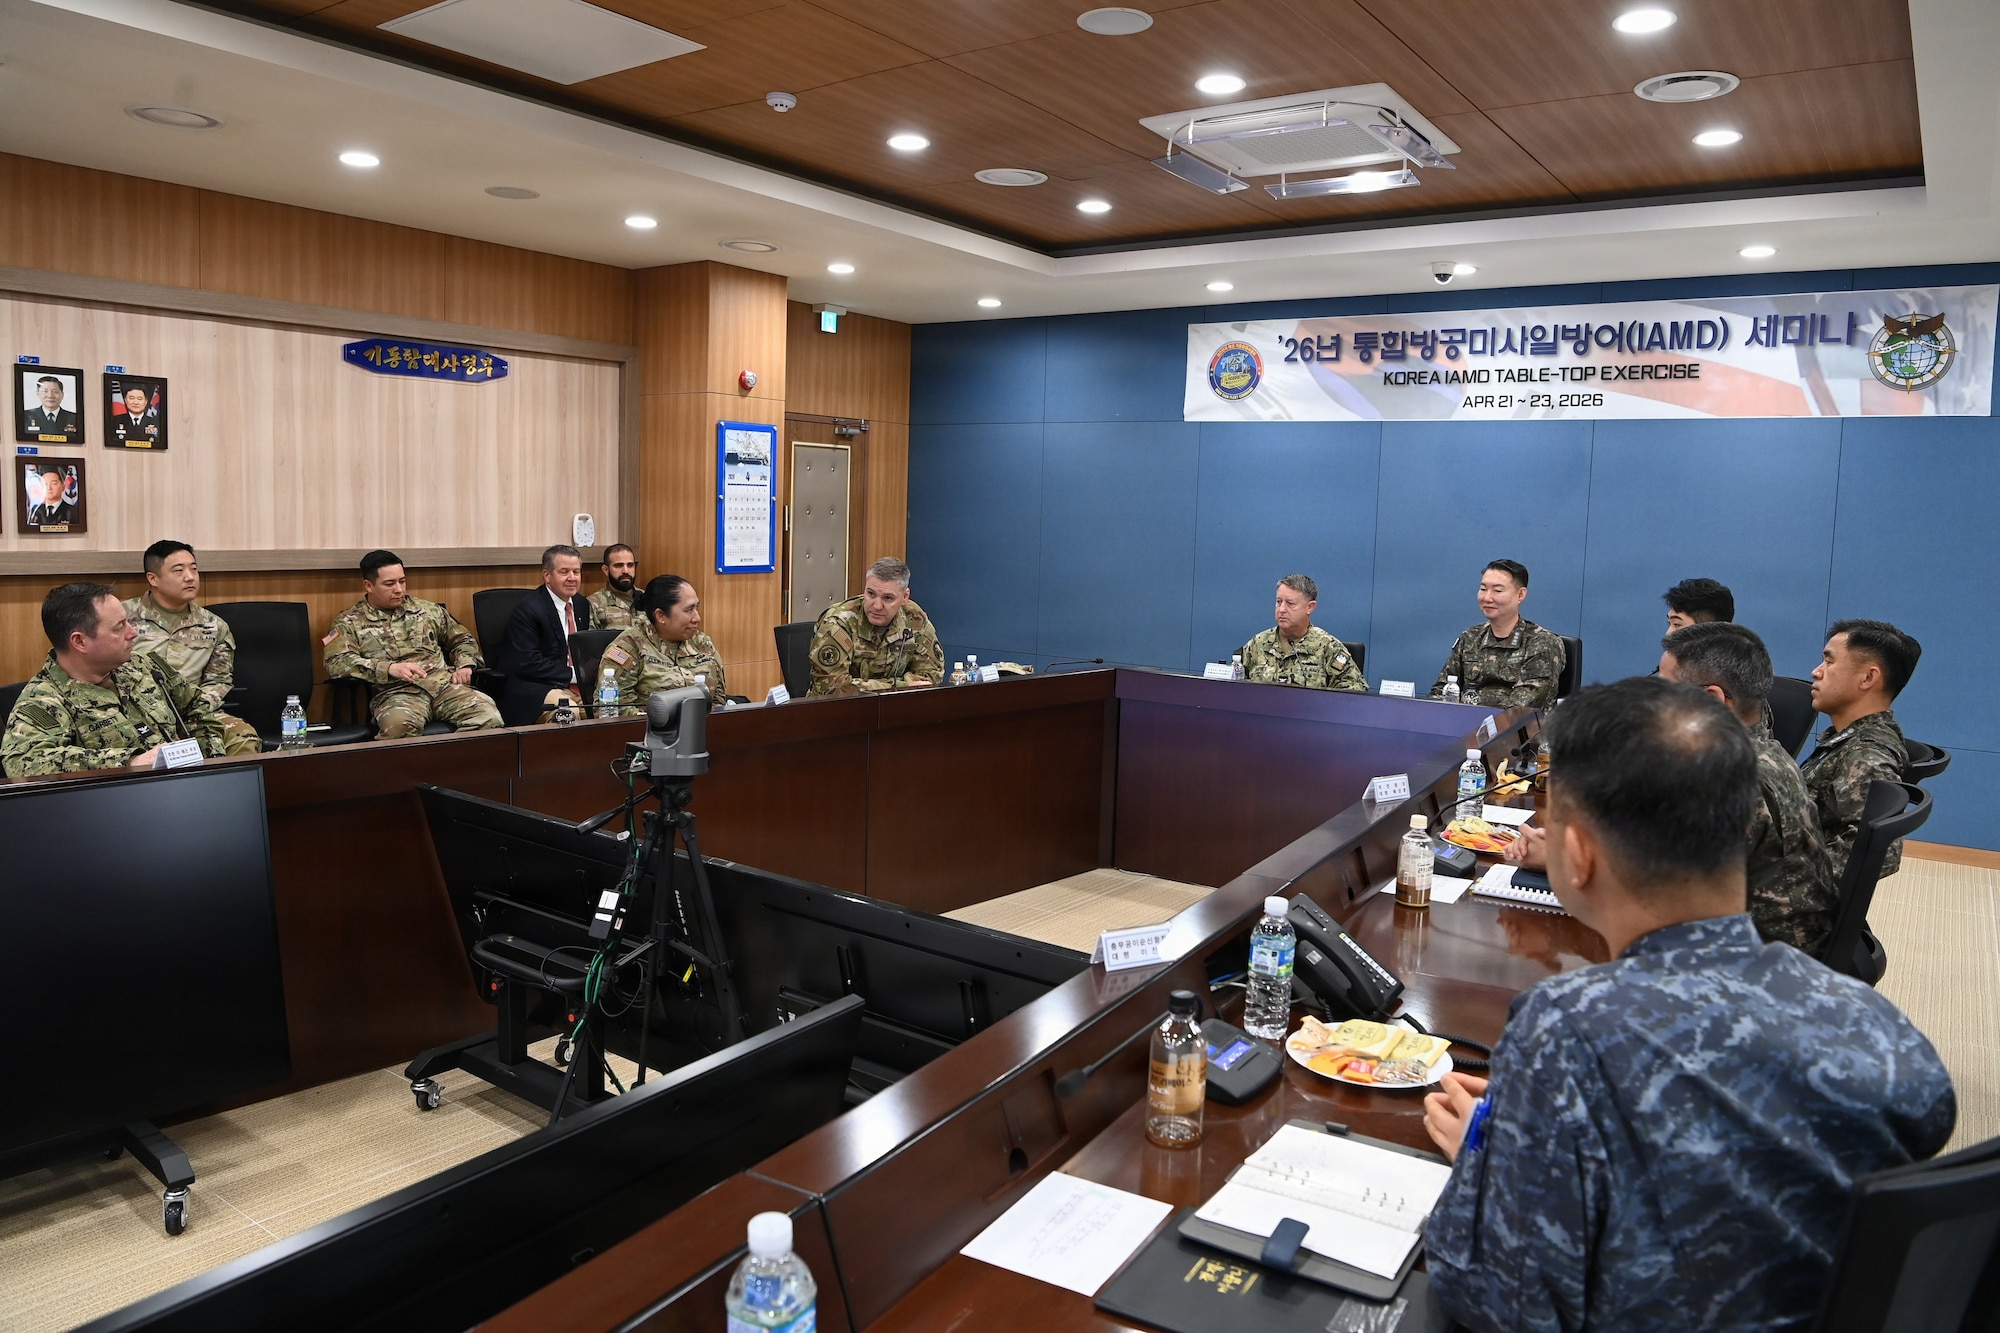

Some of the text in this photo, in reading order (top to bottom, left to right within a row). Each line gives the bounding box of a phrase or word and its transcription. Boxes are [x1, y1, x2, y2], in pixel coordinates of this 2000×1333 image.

[1353, 316, 1729, 363] 통합방공미사일방어(IAMD)
[1744, 311, 1857, 348] 세미나
[363, 345, 494, 378] 기동함대사령부
[1383, 363, 1700, 386] KOREA IAMD TABLE-TOP EXERCISE
[1462, 395, 1494, 409] APR
[1498, 395, 1513, 408] 21
[1530, 394, 1554, 410] 23,
[1559, 393, 1604, 407] 2026
